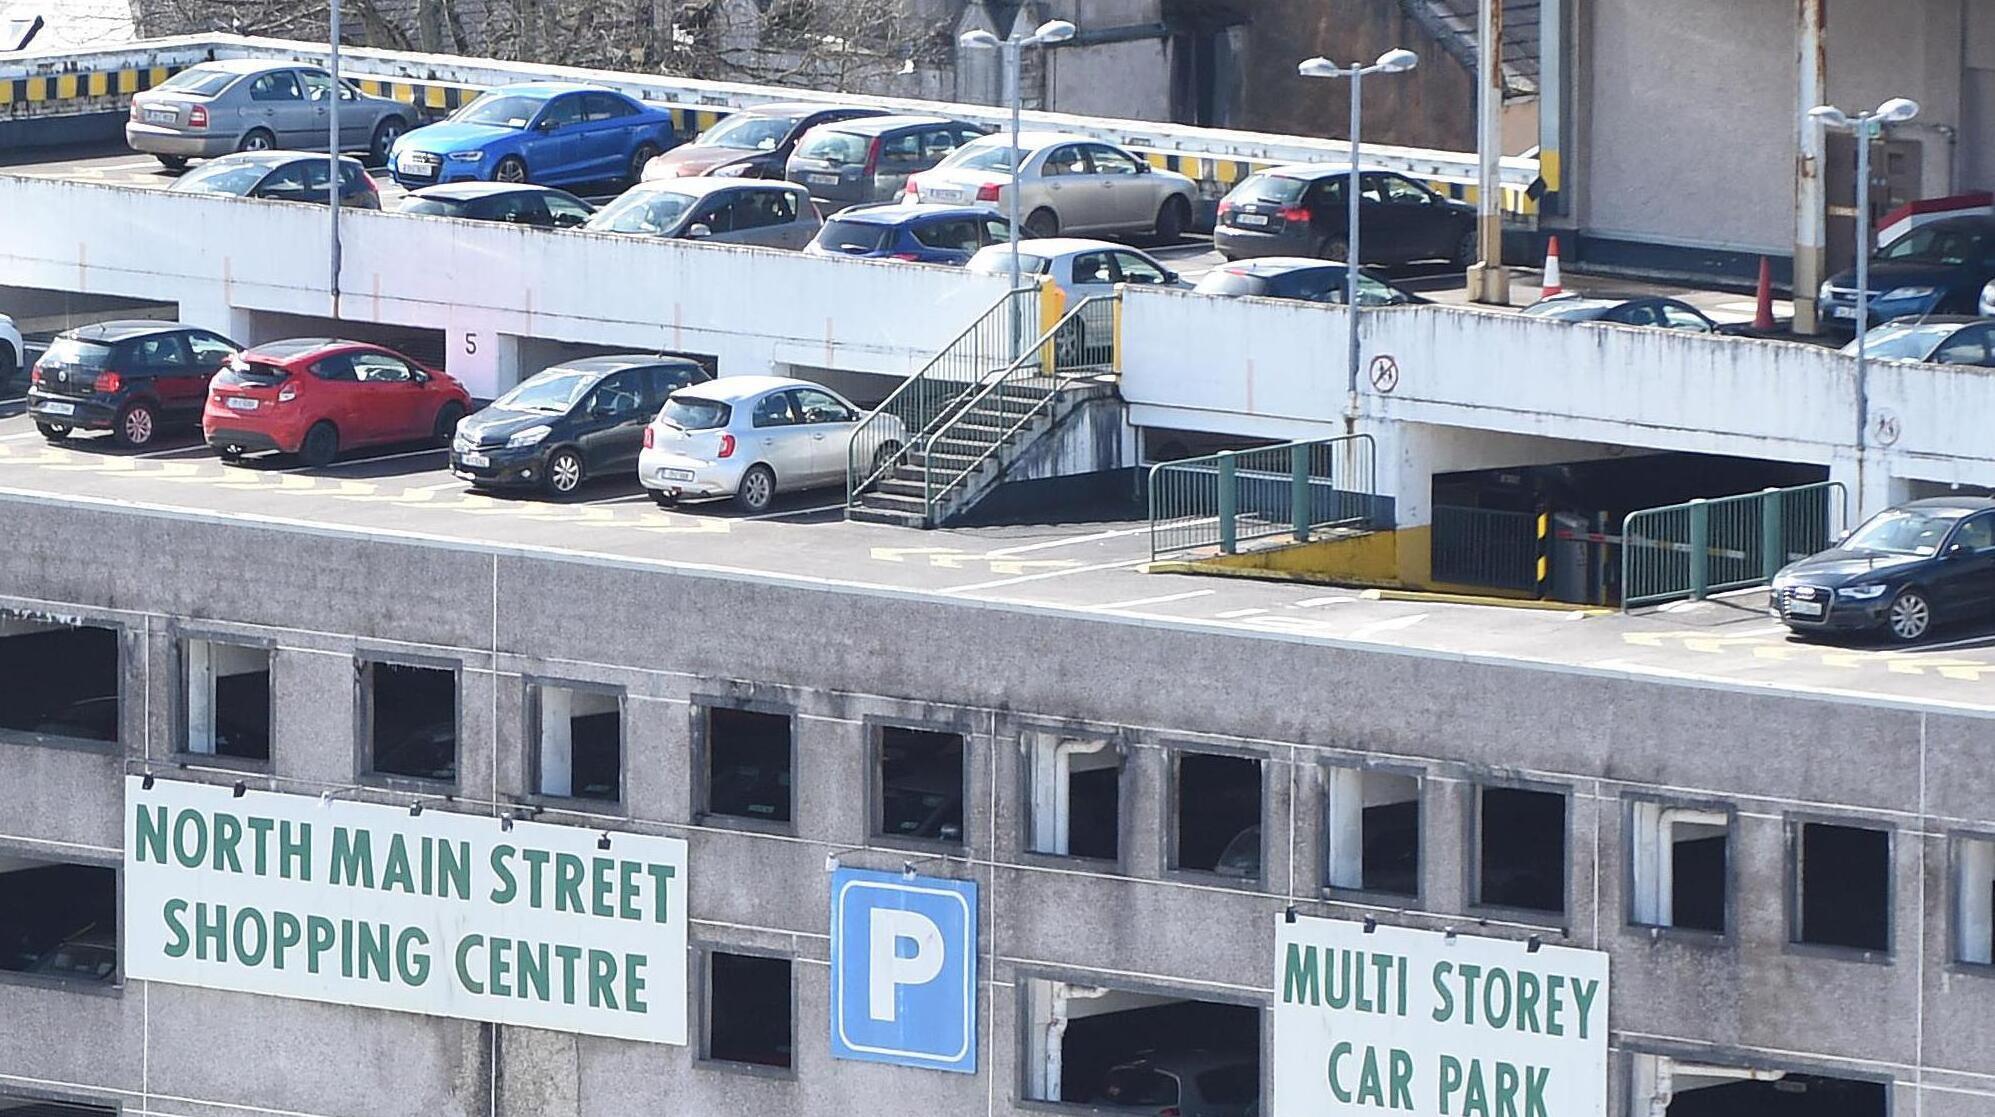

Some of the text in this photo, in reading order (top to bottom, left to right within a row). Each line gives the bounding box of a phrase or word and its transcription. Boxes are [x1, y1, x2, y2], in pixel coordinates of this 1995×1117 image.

[465, 332, 477, 355] 5
[136, 804, 677, 924] NORTH MAIN STREET
[163, 898, 649, 1014] SHOPPING CENTRE
[869, 907, 945, 1022] P
[1284, 943, 1598, 1039] MULTI STOREY
[1328, 1041, 1552, 1117] CAR PARK
